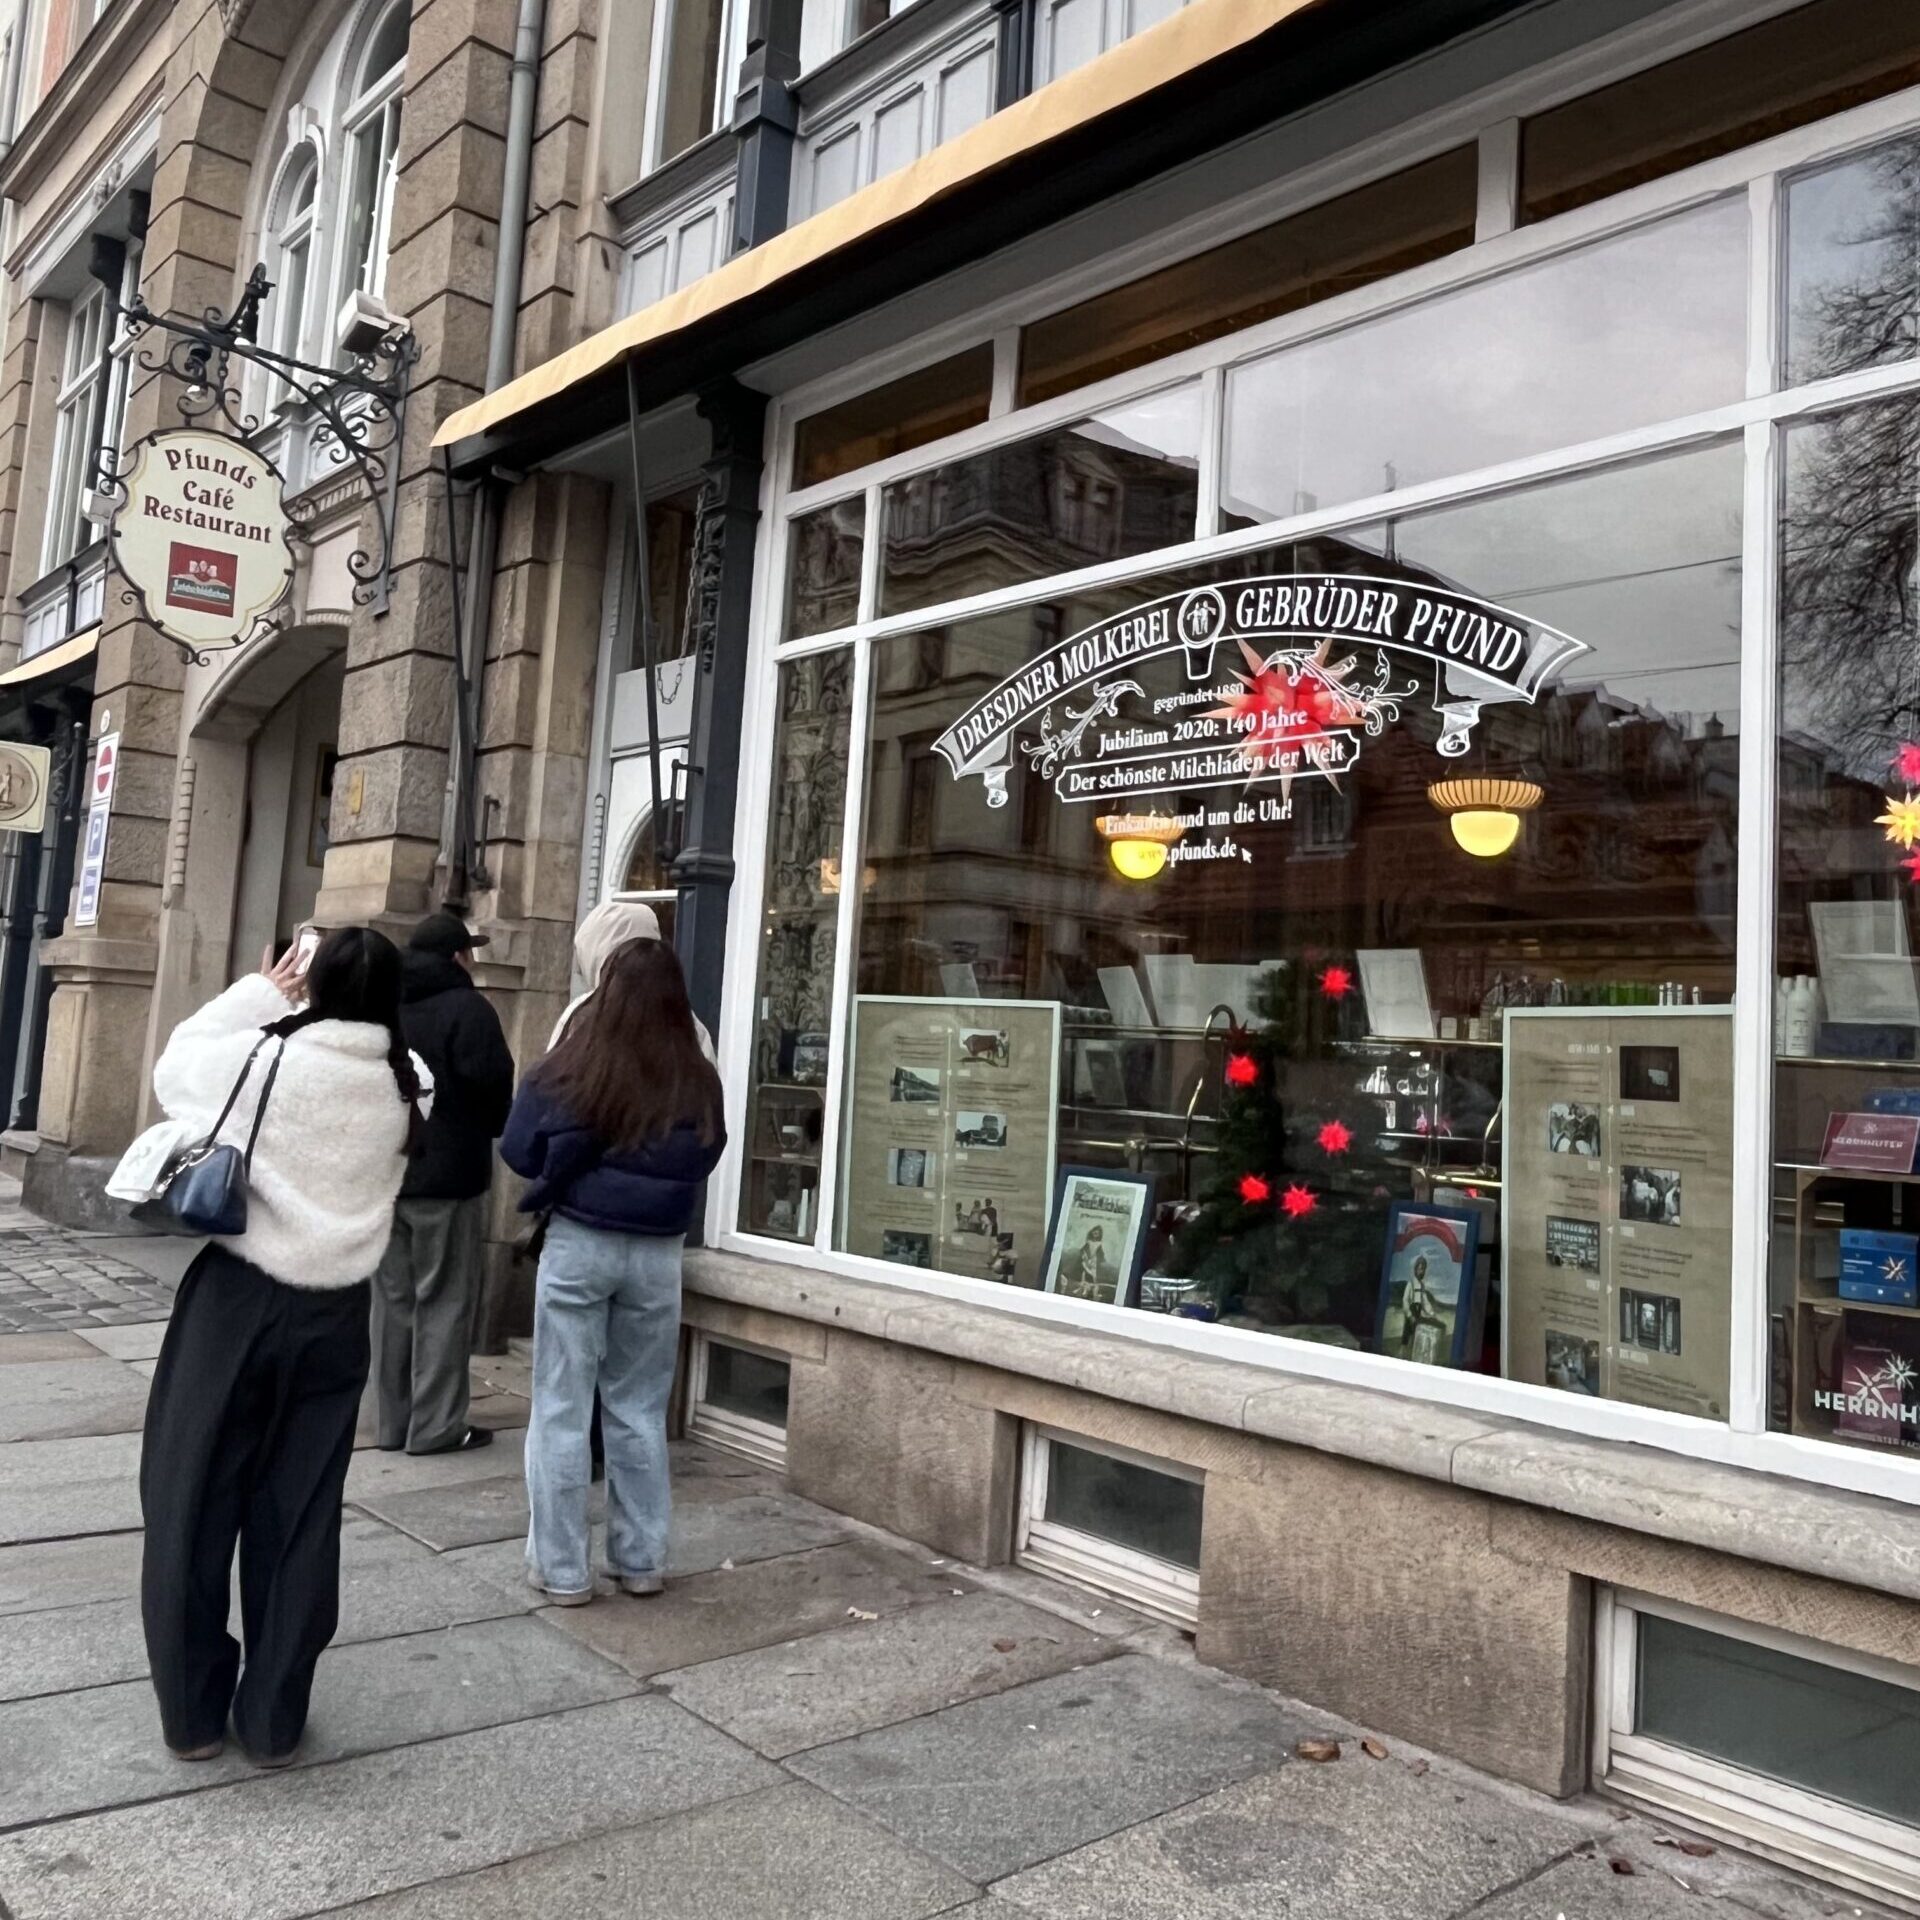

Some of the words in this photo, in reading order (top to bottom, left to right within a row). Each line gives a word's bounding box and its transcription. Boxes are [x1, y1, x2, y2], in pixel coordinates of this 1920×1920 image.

[165, 448, 257, 489] Pfunds
[183, 480, 234, 510] Café
[144, 495, 272, 543] Restaurant
[956, 660, 1060, 757] DRESDNER
[1059, 608, 1170, 684] MOLKEREI
[1236, 579, 1399, 637] GEBRÜDER
[1404, 598, 1522, 671] PFUND
[1153, 687, 1213, 714] gegründet
[1097, 728, 1168, 757] Jubiläum
[1172, 718, 1220, 741] 2020:
[1226, 712, 1256, 736] 140
[1260, 706, 1308, 733] Jahre
[1069, 773, 1097, 792] Der
[1099, 765, 1167, 788] schönste
[1170, 750, 1265, 781] Milchladen
[1268, 745, 1300, 769] der
[1303, 739, 1344, 765] Welt
[1208, 811, 1230, 826] um
[1233, 802, 1256, 824] die
[1259, 798, 1292, 822] Uhr!
[1814, 1389, 1920, 1424] HERRNH
